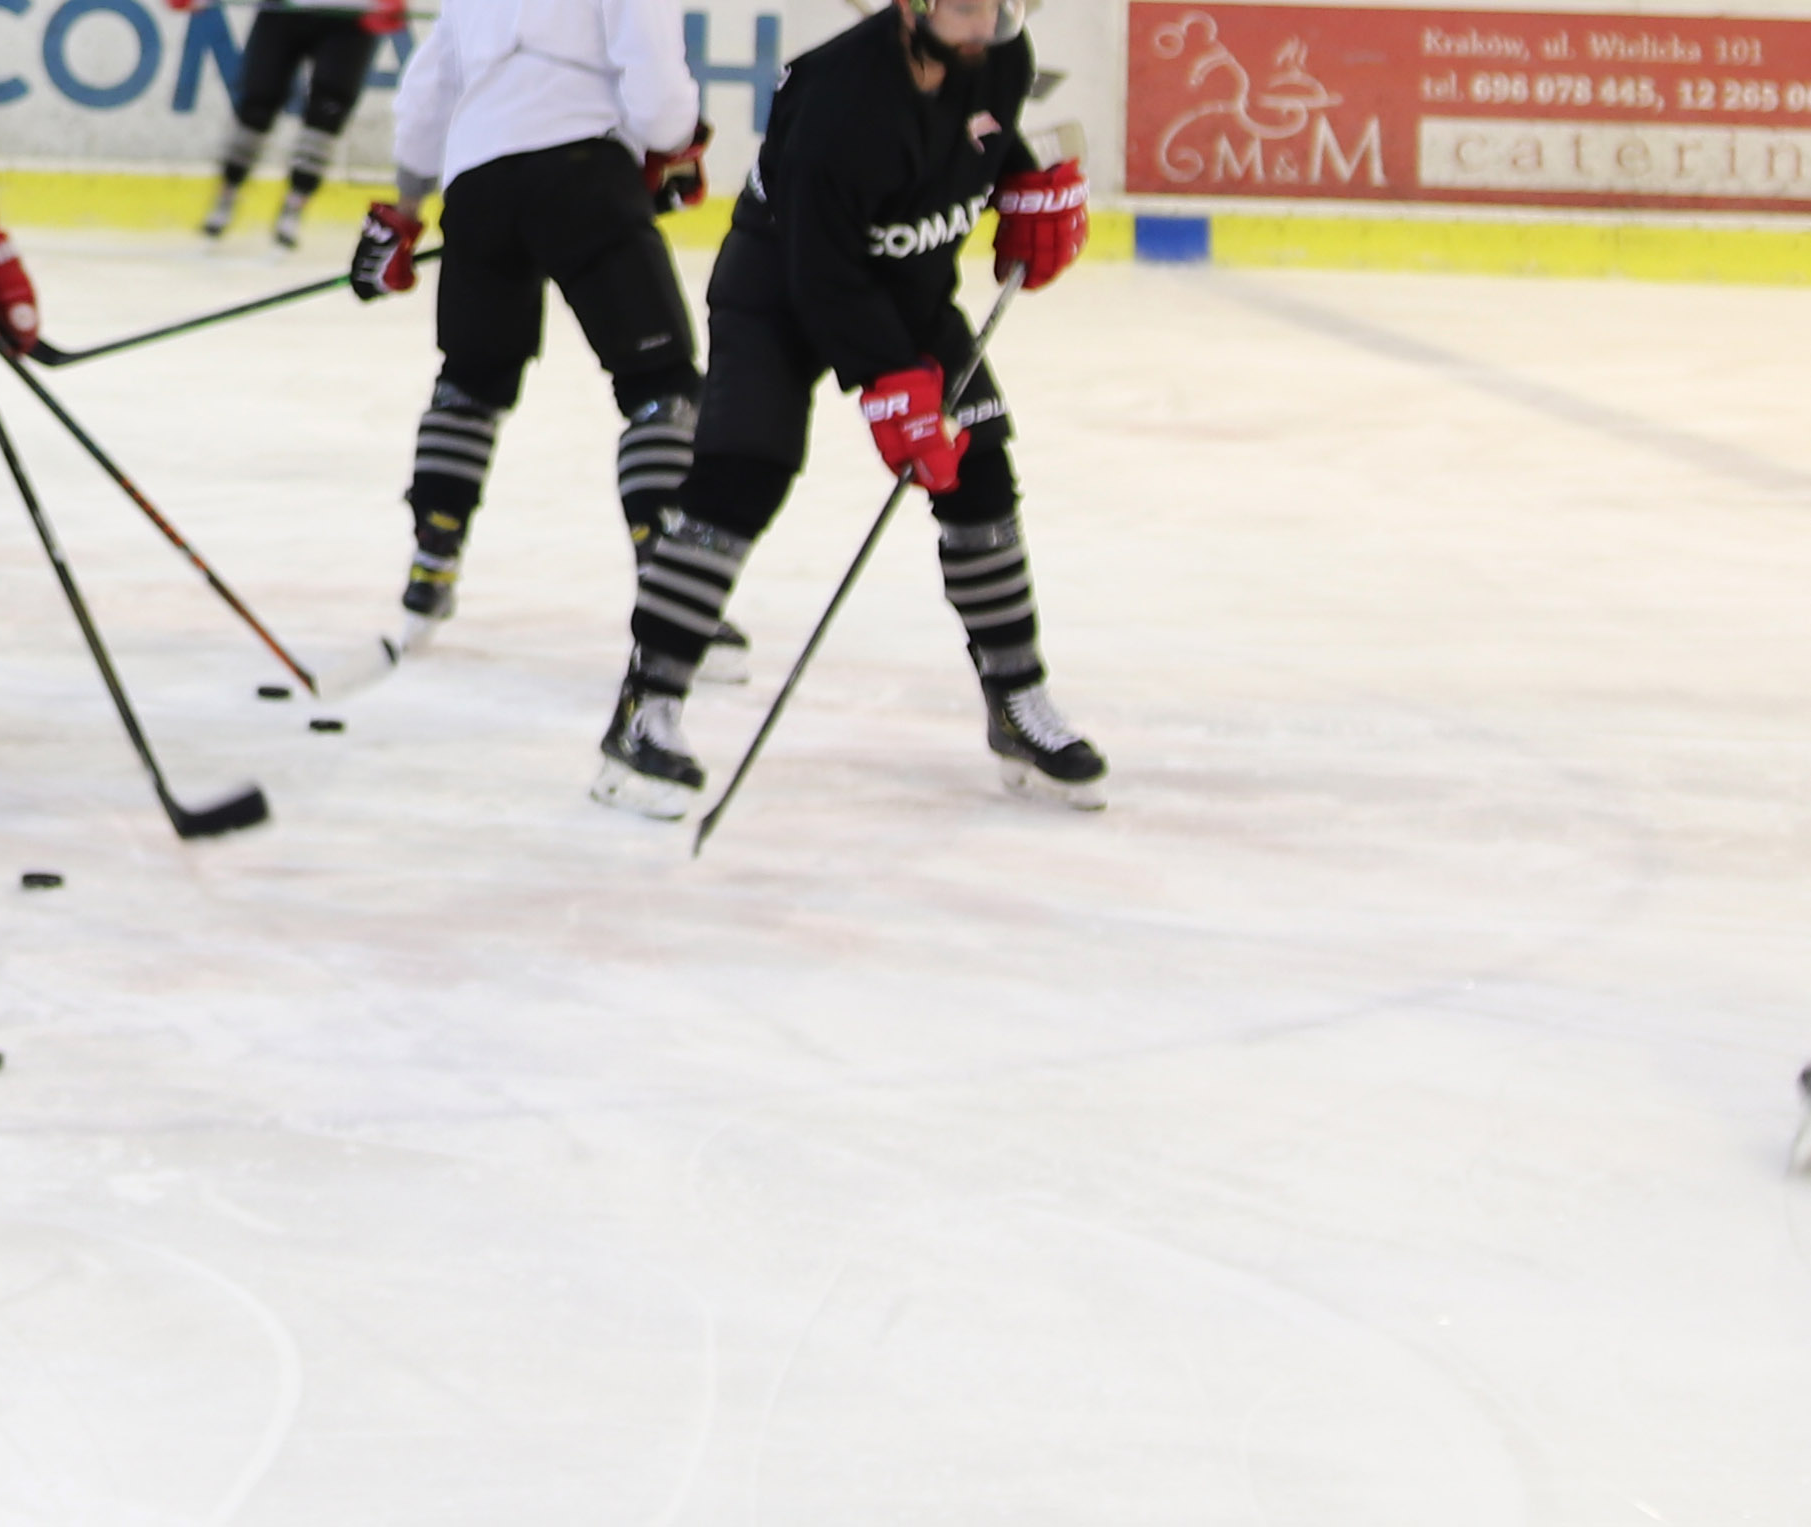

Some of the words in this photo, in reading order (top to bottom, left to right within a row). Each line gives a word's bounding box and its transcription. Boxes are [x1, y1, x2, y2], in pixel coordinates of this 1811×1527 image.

[1422, 70, 1464, 103] tel.
[1471, 72, 1529, 104] 696
[1535, 74, 1592, 106] 078
[1679, 77, 1716, 111] 12
[1722, 77, 1779, 113] 265
